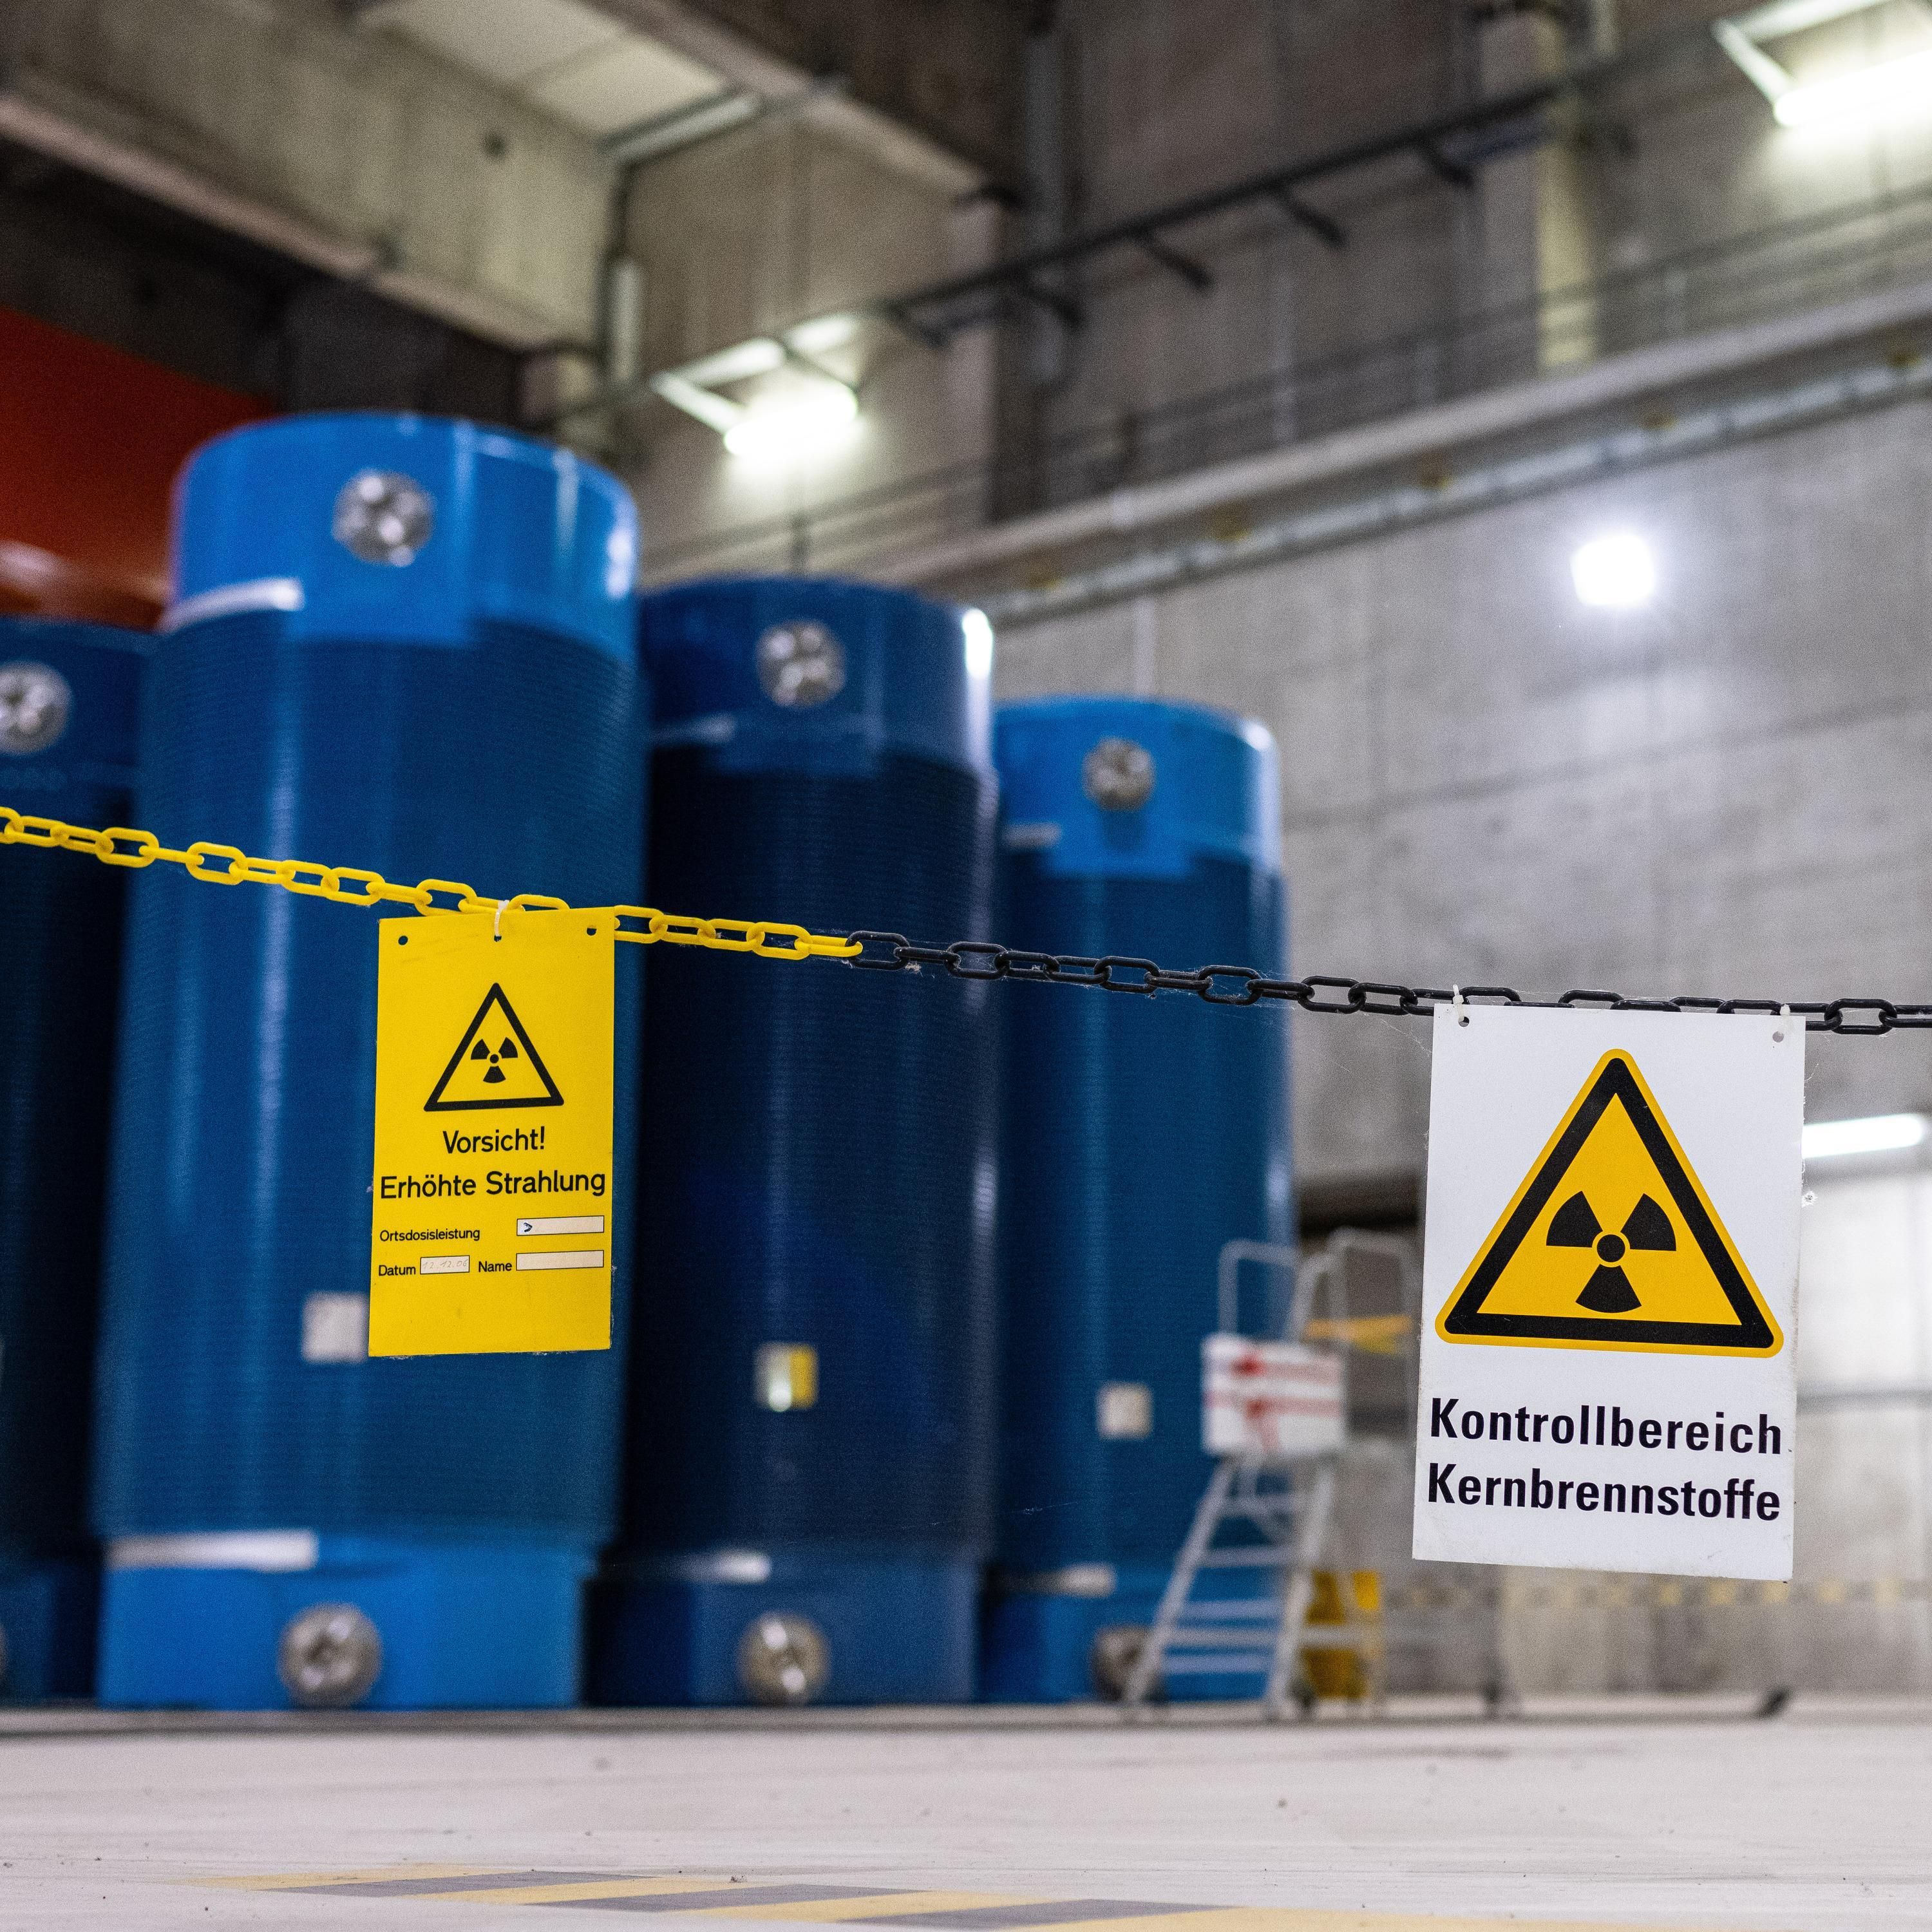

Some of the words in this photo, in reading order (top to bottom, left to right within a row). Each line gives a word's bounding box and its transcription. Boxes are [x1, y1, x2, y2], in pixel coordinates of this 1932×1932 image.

[443, 1126, 545, 1154] Vorsicht!
[381, 1175, 477, 1199] Erhöhte
[486, 1170, 605, 1197] Strahlung
[379, 1228, 480, 1241] Ortsdosisleistung
[379, 1265, 416, 1276] Datum
[478, 1261, 513, 1273] Name
[1430, 1397, 1782, 1455] Kontrollbereich
[1428, 1463, 1780, 1520] Kernbrennstoffe
